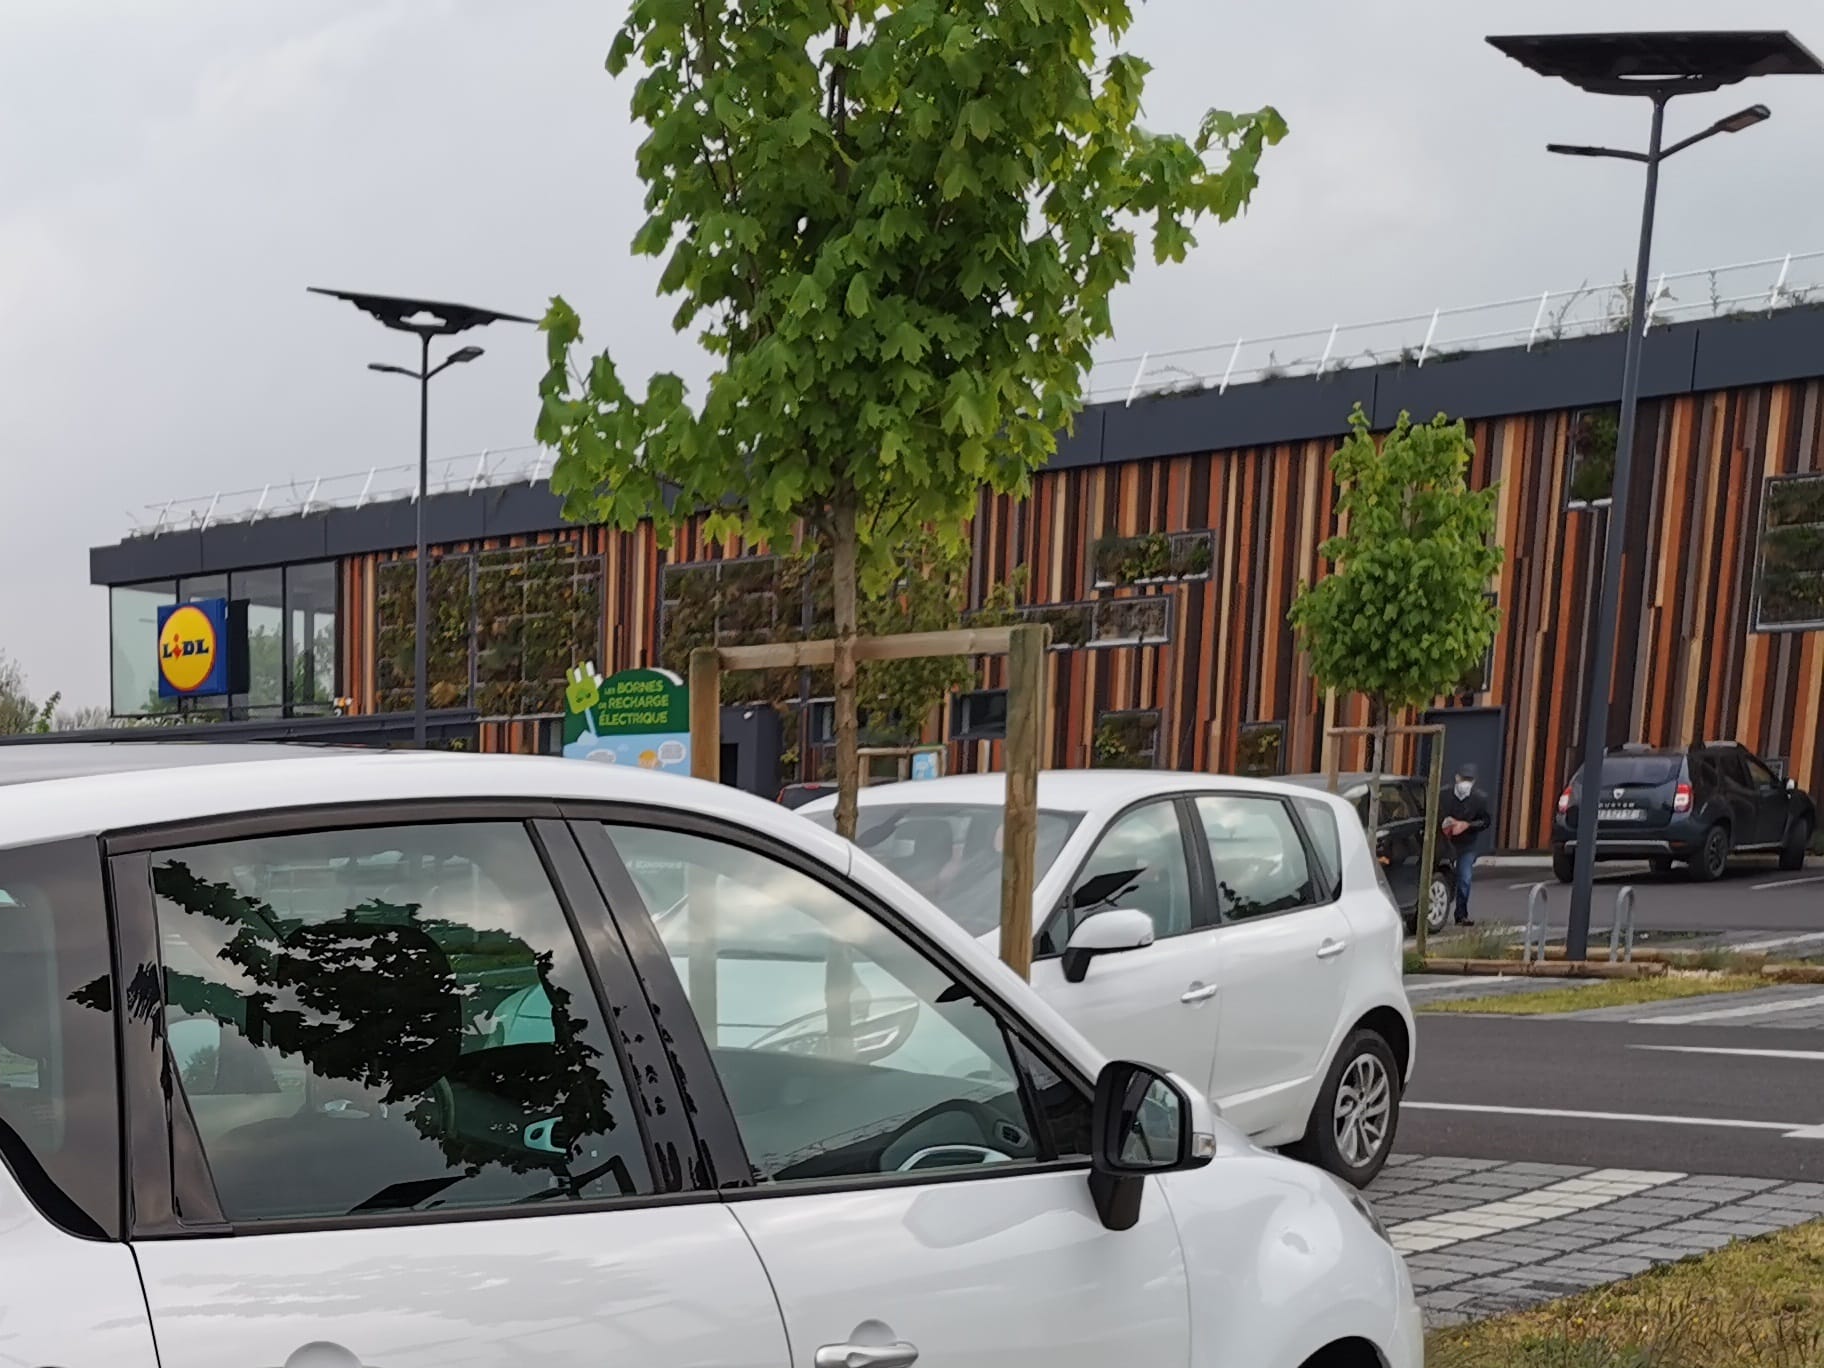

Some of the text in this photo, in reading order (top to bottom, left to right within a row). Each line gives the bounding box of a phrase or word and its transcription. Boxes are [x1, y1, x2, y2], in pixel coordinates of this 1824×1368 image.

[618, 680, 663, 693] BORNES
[609, 695, 669, 709] RECHARGE
[599, 711, 667, 725] ÉLECTRIQUE
